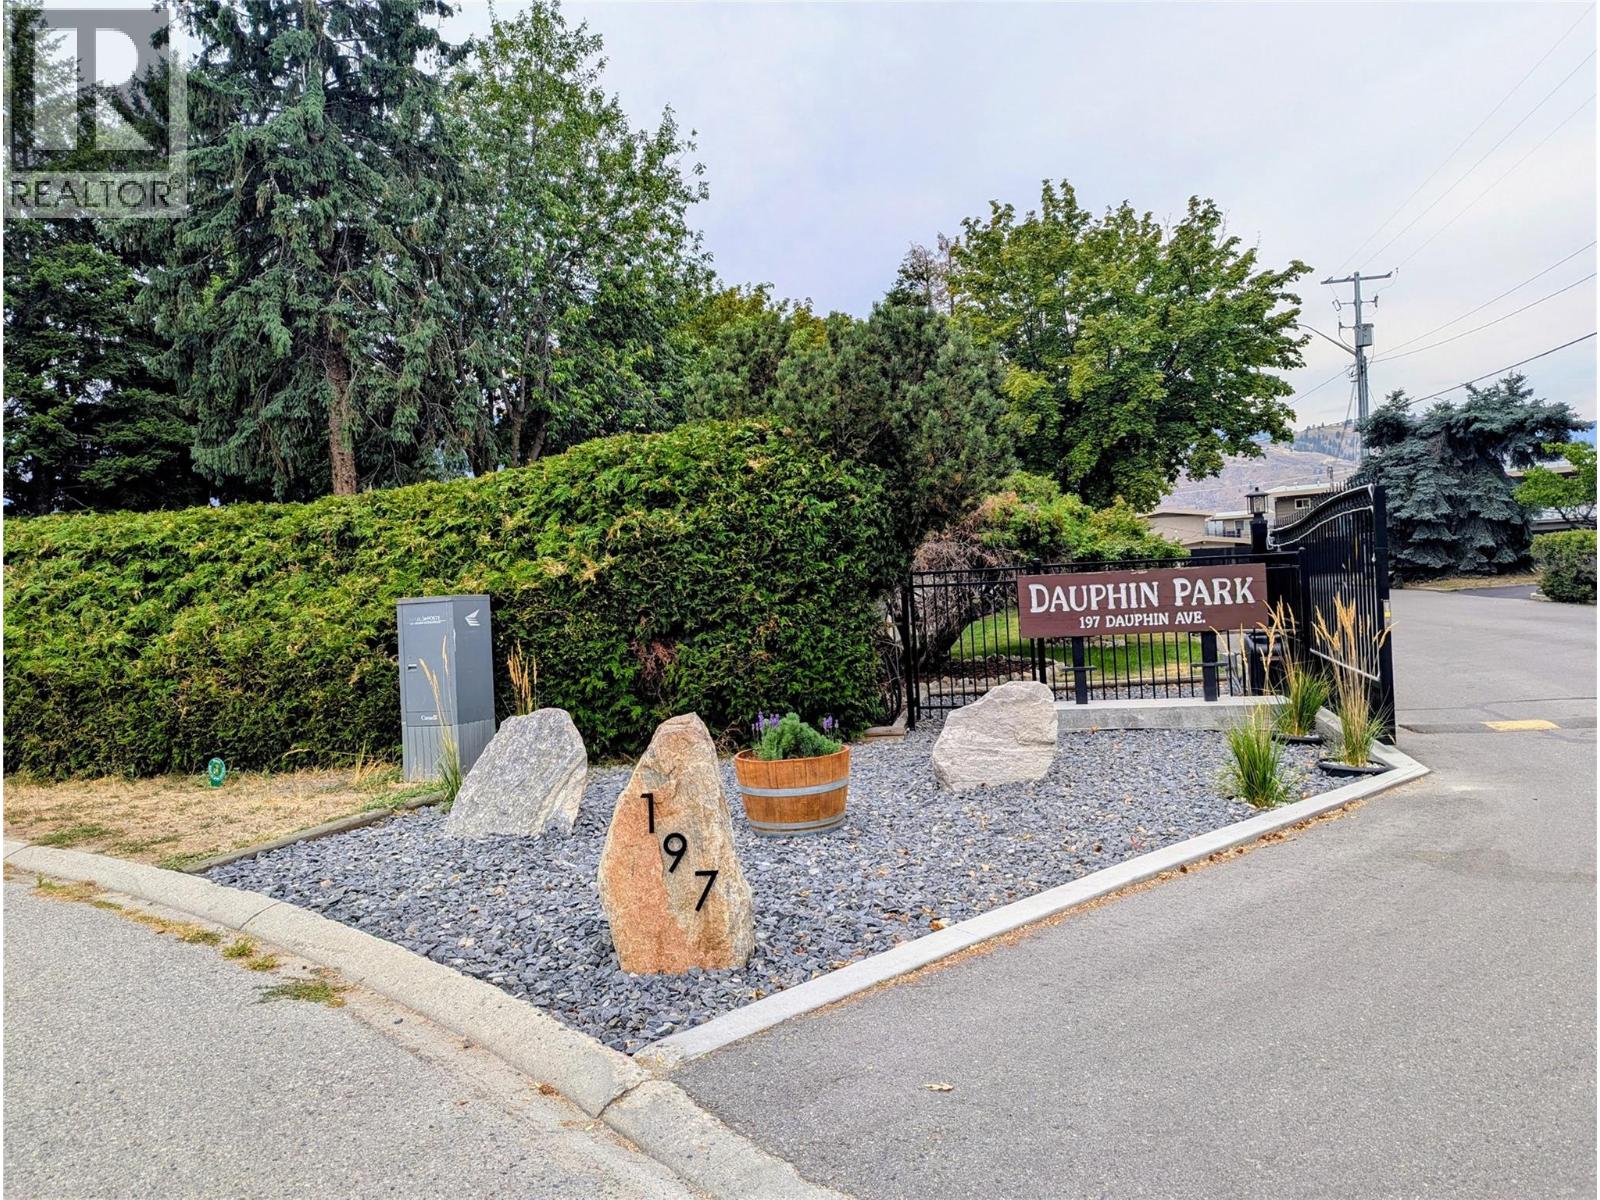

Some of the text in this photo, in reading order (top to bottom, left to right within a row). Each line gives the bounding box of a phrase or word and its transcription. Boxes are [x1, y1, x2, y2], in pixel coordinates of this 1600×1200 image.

[1028, 577, 1255, 613] DAUPHIN PARK
[1079, 611, 1206, 629] 197 DAUPHIN AVE.
[640, 792, 719, 912] 197
